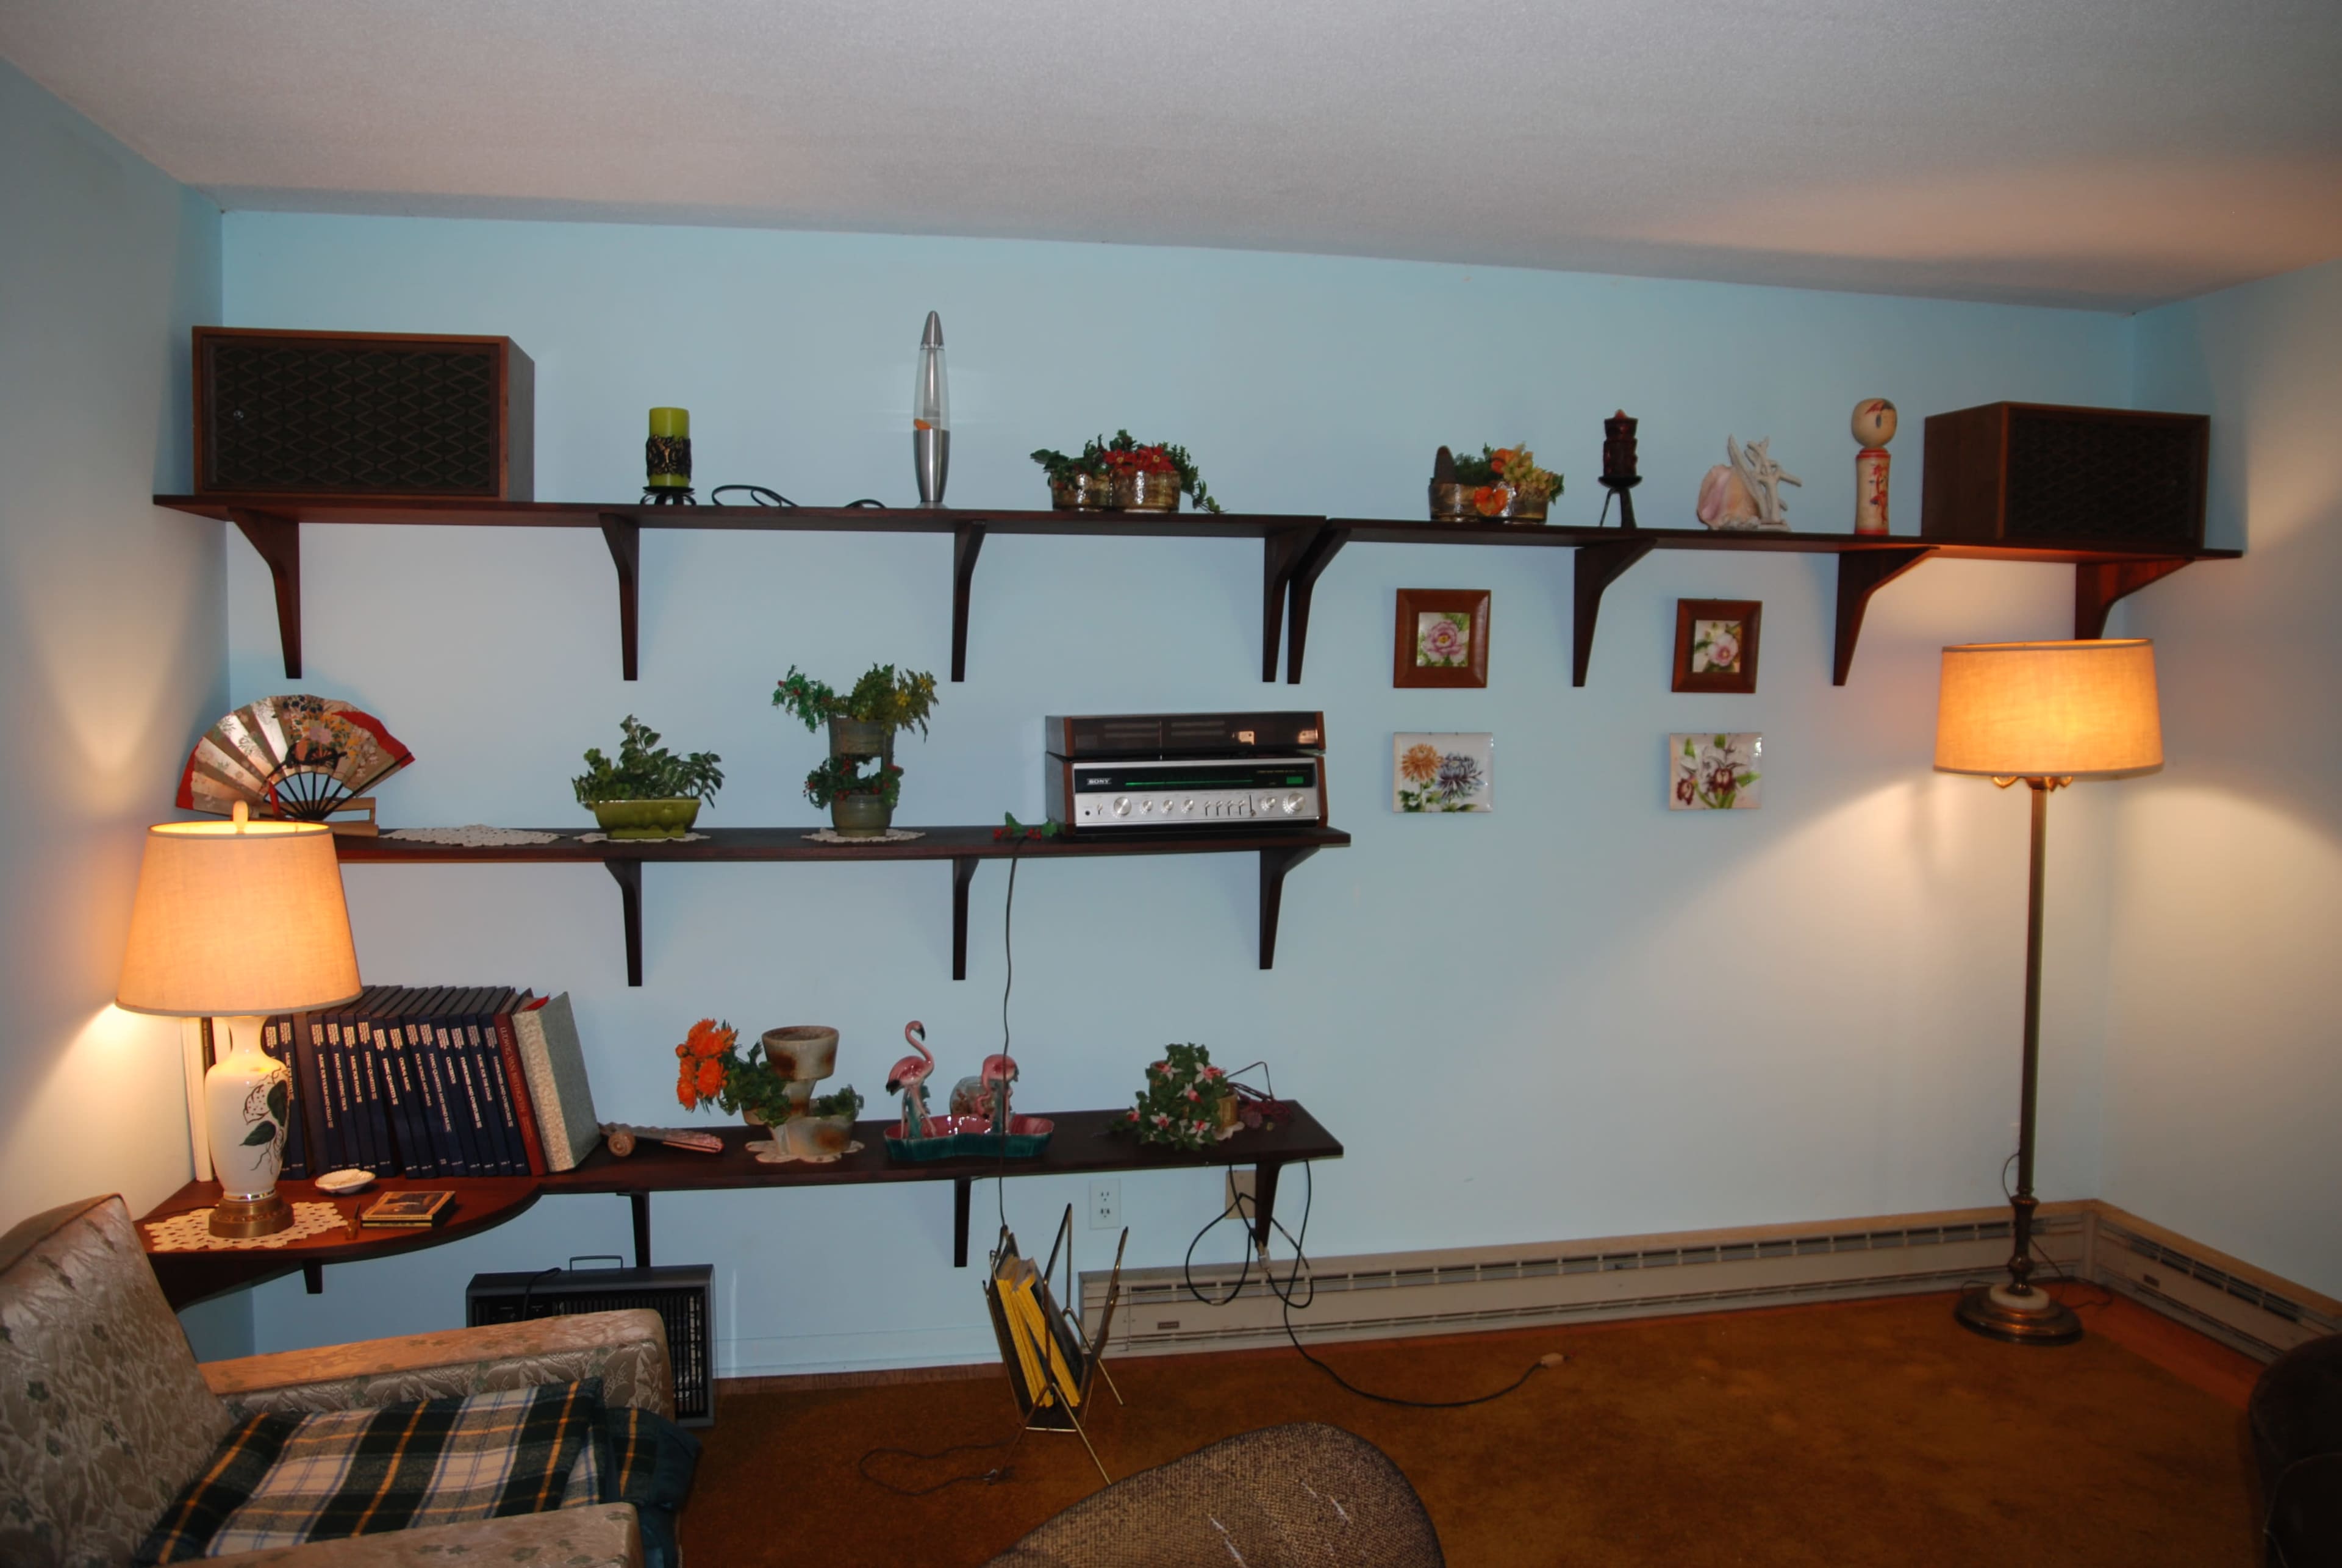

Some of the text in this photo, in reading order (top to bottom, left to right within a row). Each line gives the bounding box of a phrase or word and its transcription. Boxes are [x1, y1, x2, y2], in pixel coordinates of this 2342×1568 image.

[500, 1026, 526, 1112] LUDWIG VAN BEETHOVEN
